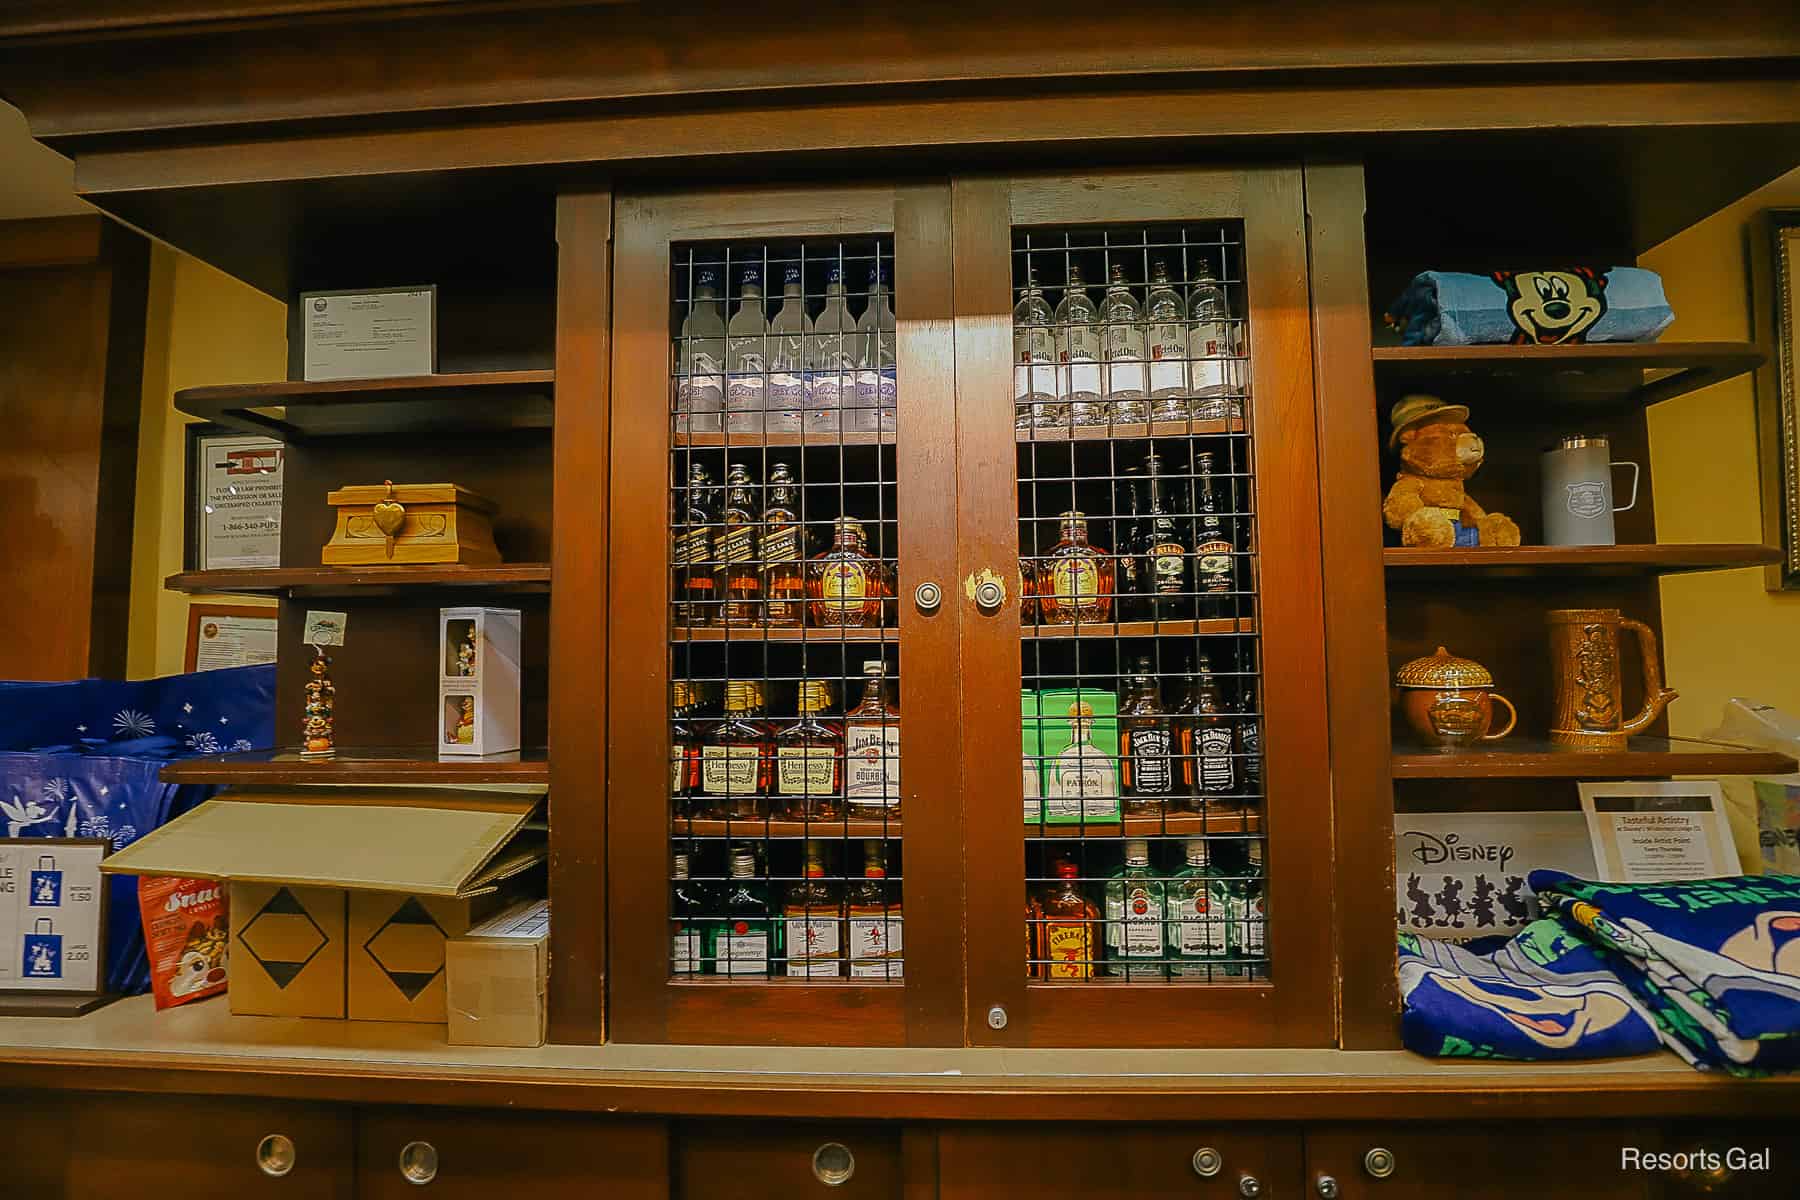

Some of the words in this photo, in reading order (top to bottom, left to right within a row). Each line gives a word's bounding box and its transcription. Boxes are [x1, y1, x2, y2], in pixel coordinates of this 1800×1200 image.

[869, 734, 894, 752] BEM
[787, 760, 825, 770] Henessy
[856, 771, 890, 781] BOURBN
